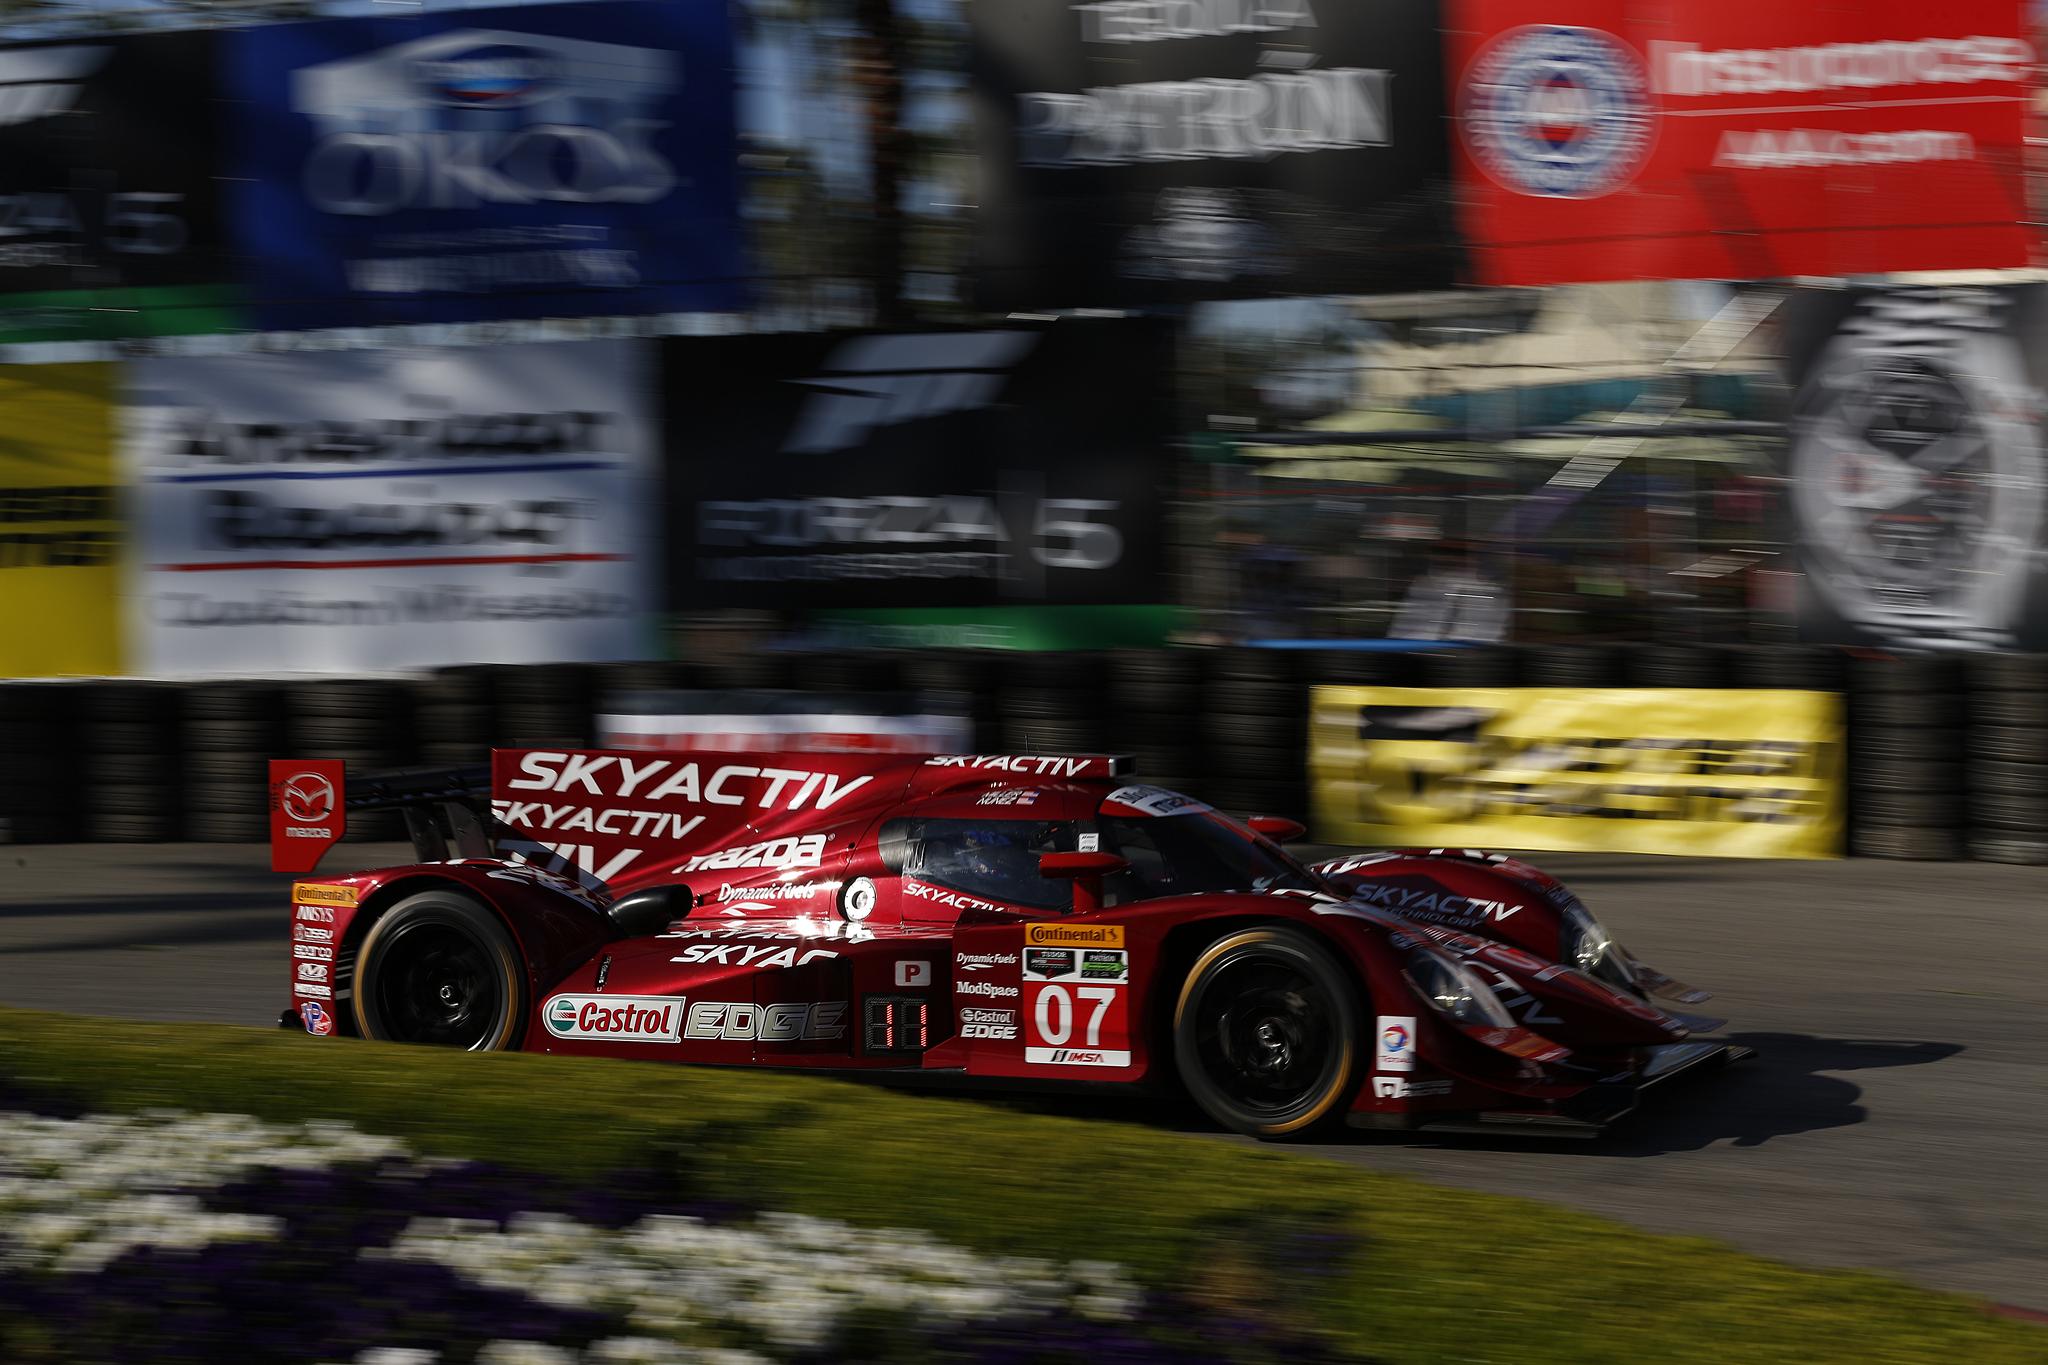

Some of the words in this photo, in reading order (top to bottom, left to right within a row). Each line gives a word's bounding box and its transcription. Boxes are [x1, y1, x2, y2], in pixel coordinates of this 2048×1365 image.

[924, 755, 1092, 777] SKYACTIV
[508, 751, 873, 811] SKYACTIV
[1350, 884, 1524, 921] SKYACTIV
[1030, 926, 1106, 943] Continental
[904, 964, 920, 983] P
[956, 981, 1019, 998] ModSpace
[579, 1001, 671, 1035] Castrol
[684, 1001, 849, 1042] EDGE
[973, 1009, 1012, 1024] Castrol
[1034, 984, 1117, 1046] 07
[960, 1025, 1019, 1040] EDGE
